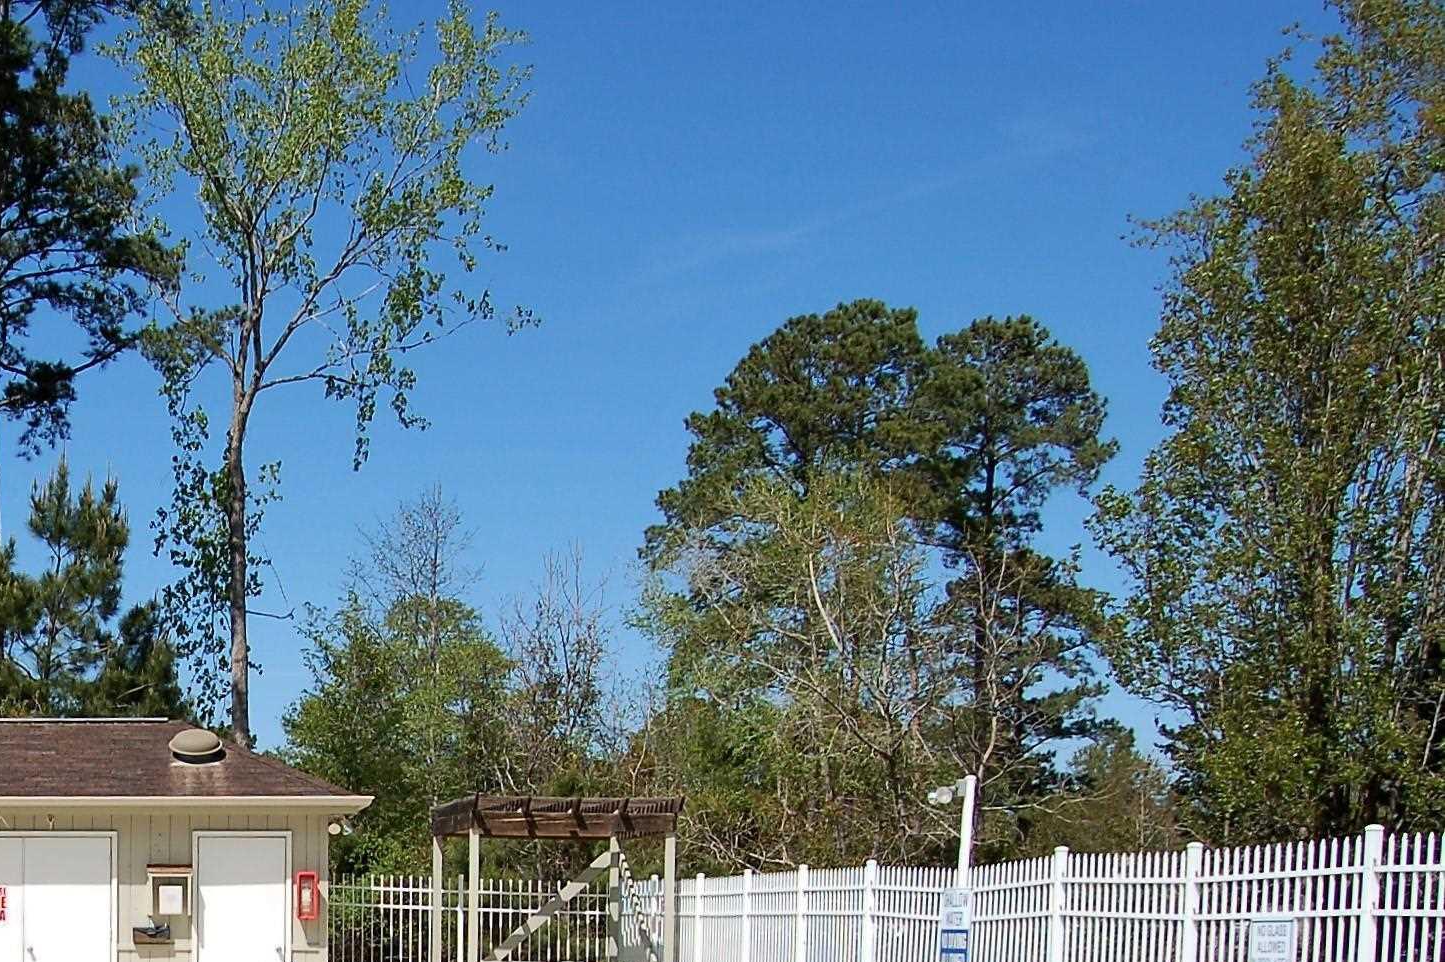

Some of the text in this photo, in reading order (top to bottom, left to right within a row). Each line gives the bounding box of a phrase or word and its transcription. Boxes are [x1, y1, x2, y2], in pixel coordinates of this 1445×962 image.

[1257, 925, 1287, 936] NO GLASS
[1257, 941, 1286, 953] ALLOWED
